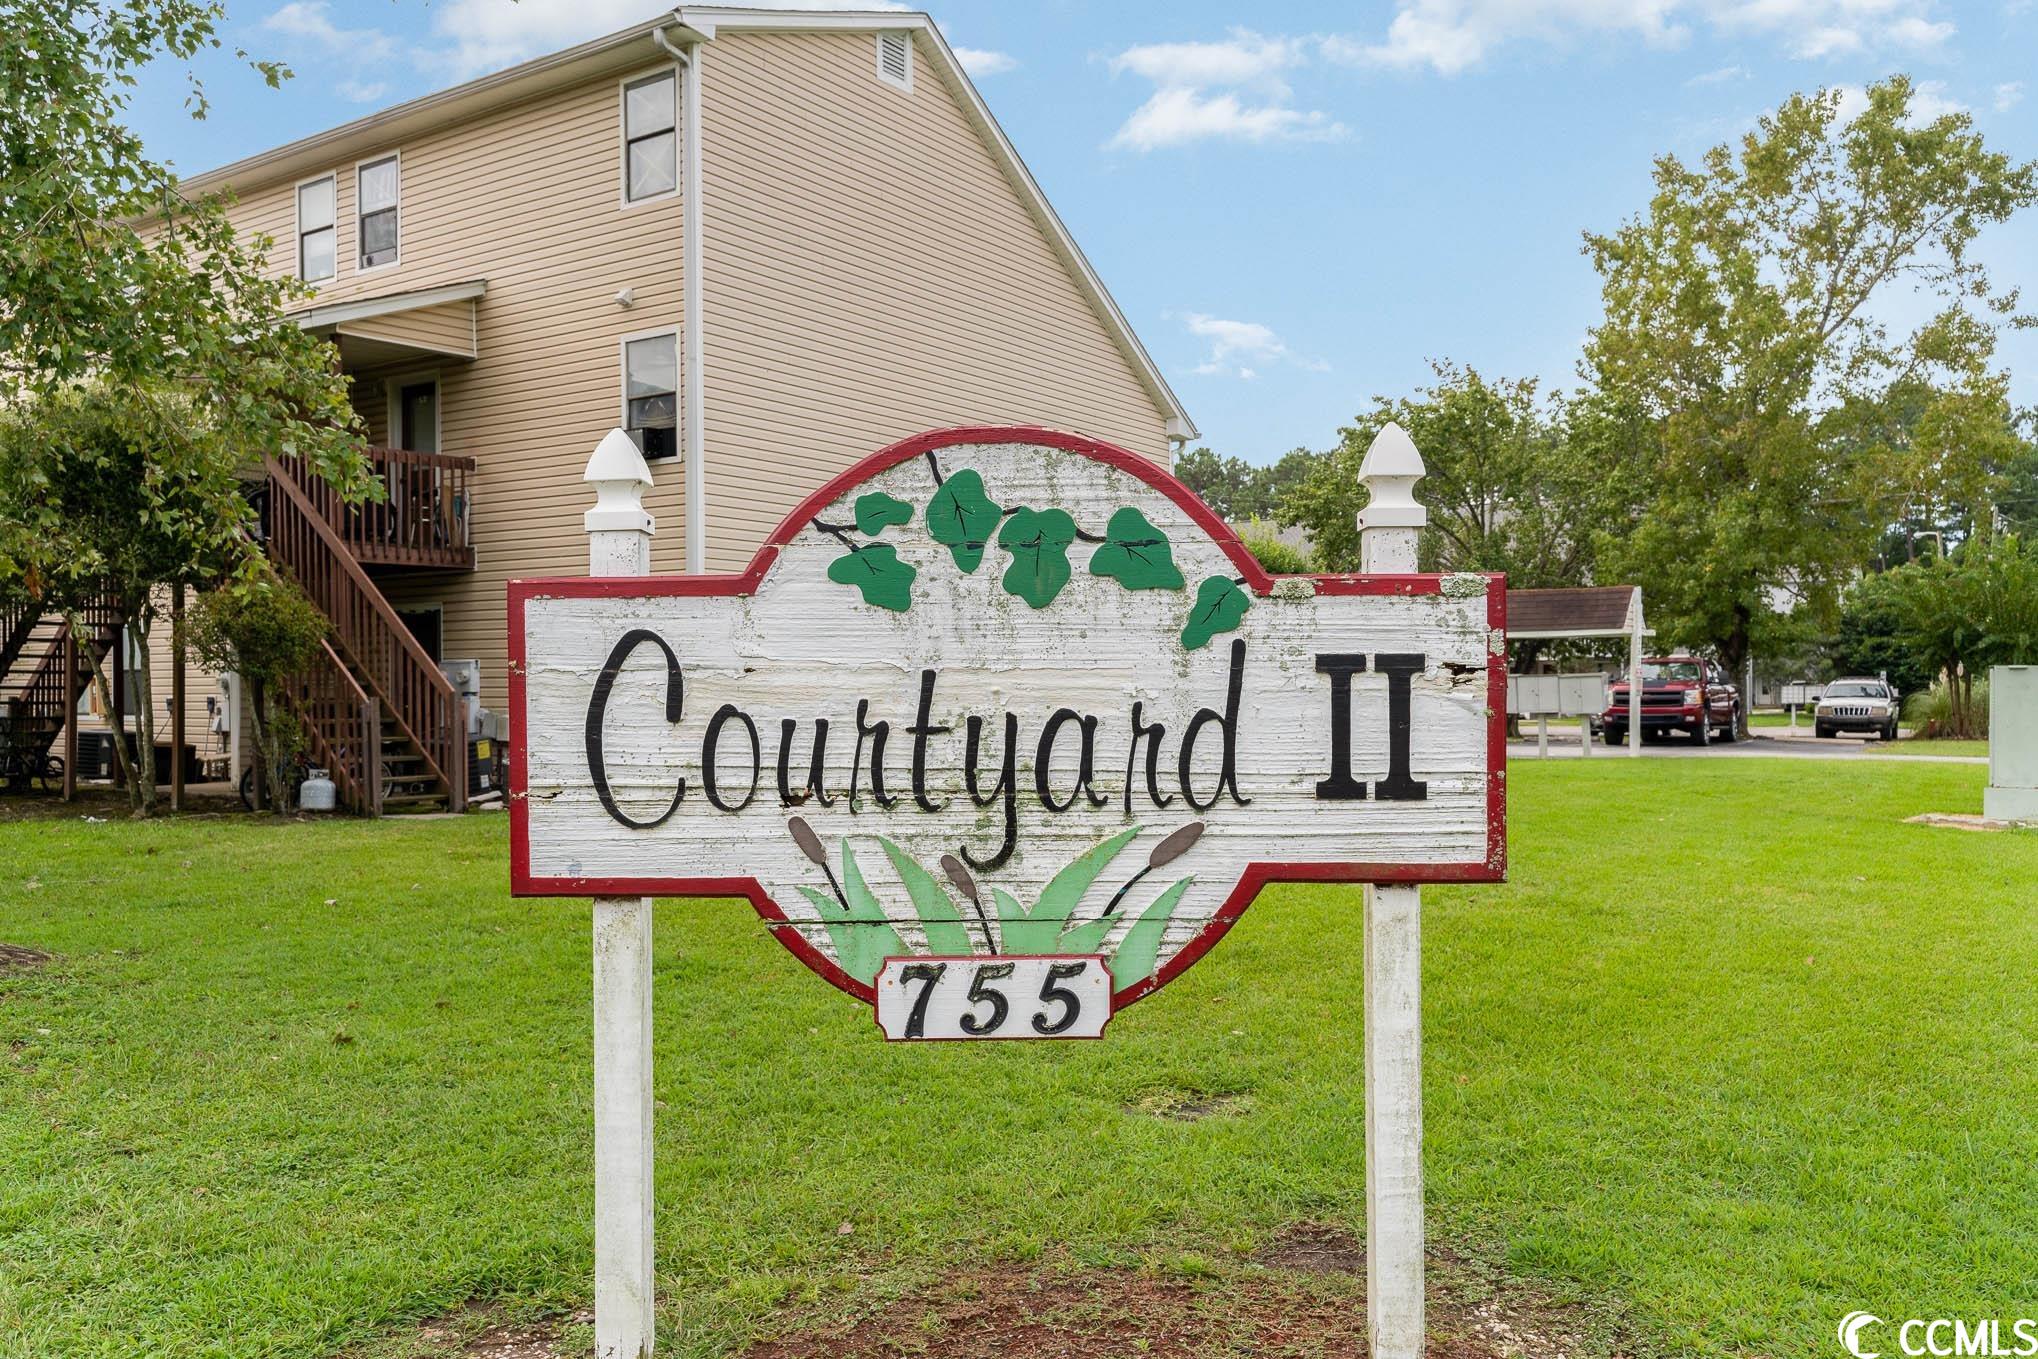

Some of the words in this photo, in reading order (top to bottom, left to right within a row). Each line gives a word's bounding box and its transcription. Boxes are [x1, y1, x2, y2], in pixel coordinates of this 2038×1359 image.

[585, 629, 1252, 872] Courtyard
[1314, 653, 1428, 801] II
[900, 962, 1087, 1037] 755
